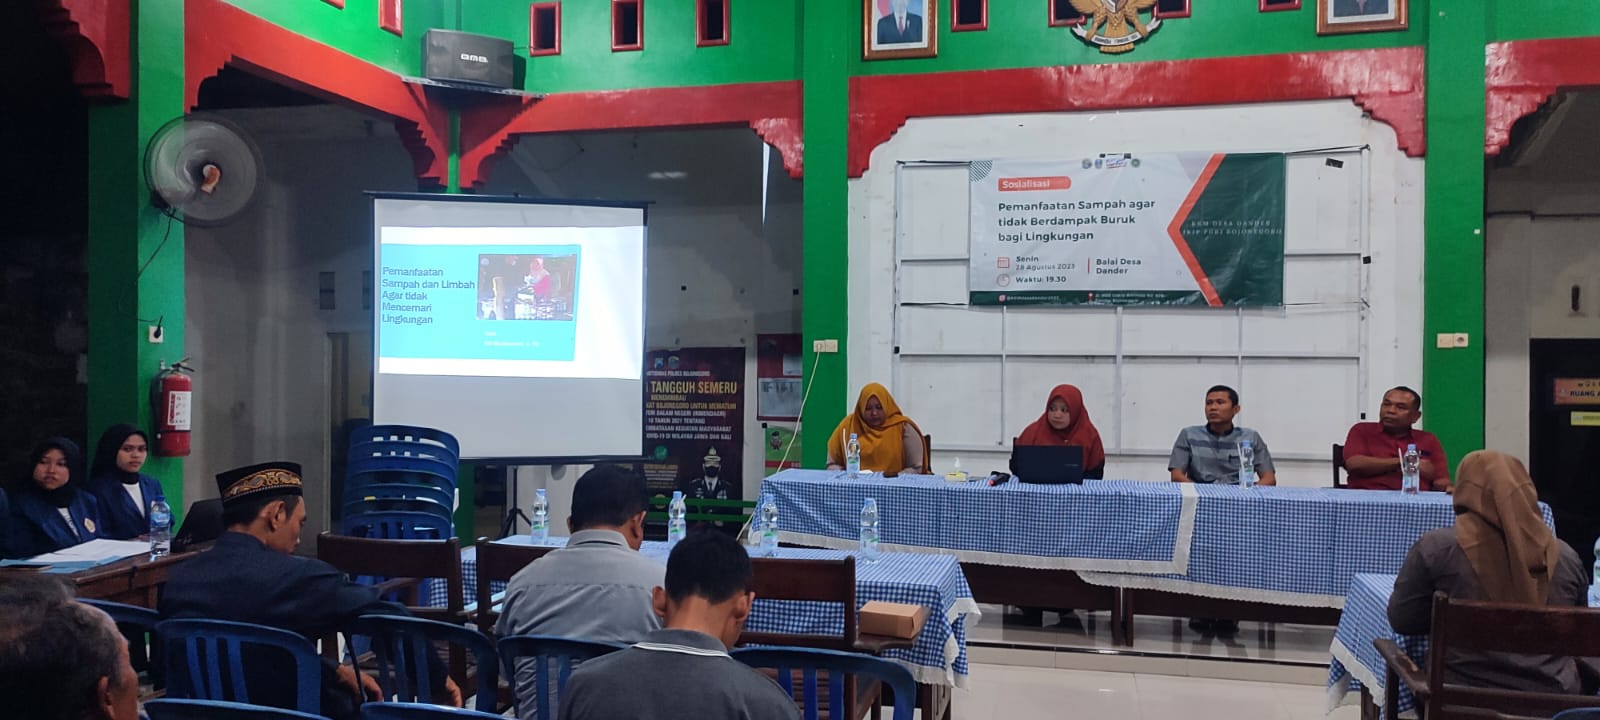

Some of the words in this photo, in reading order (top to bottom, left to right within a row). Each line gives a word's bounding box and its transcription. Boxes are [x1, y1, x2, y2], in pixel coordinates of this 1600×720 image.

[1002, 180, 1050, 189] Sosialisasi
[998, 202, 1075, 212] Pemanfaatan
[1078, 200, 1126, 213] Sampah
[1129, 200, 1155, 210] agar
[998, 217, 1027, 227] tidak
[1030, 215, 1097, 227] Berdampak
[1100, 214, 1135, 224] Buruk
[998, 232, 1023, 243] bagi
[1025, 232, 1094, 243] Lingkungan
[382, 267, 443, 276] Pemanfaatan
[1096, 267, 1129, 275] Dander
[382, 279, 420, 290] Sampah
[422, 280, 439, 288] dan
[441, 280, 475, 289] Limbah
[382, 291, 404, 300] Agar
[405, 292, 428, 300] tidak
[382, 302, 432, 312] Mencemari
[382, 314, 433, 325] Lingkungan
[651, 382, 695, 393] TANGGUH
[698, 382, 737, 394] SEMERU
